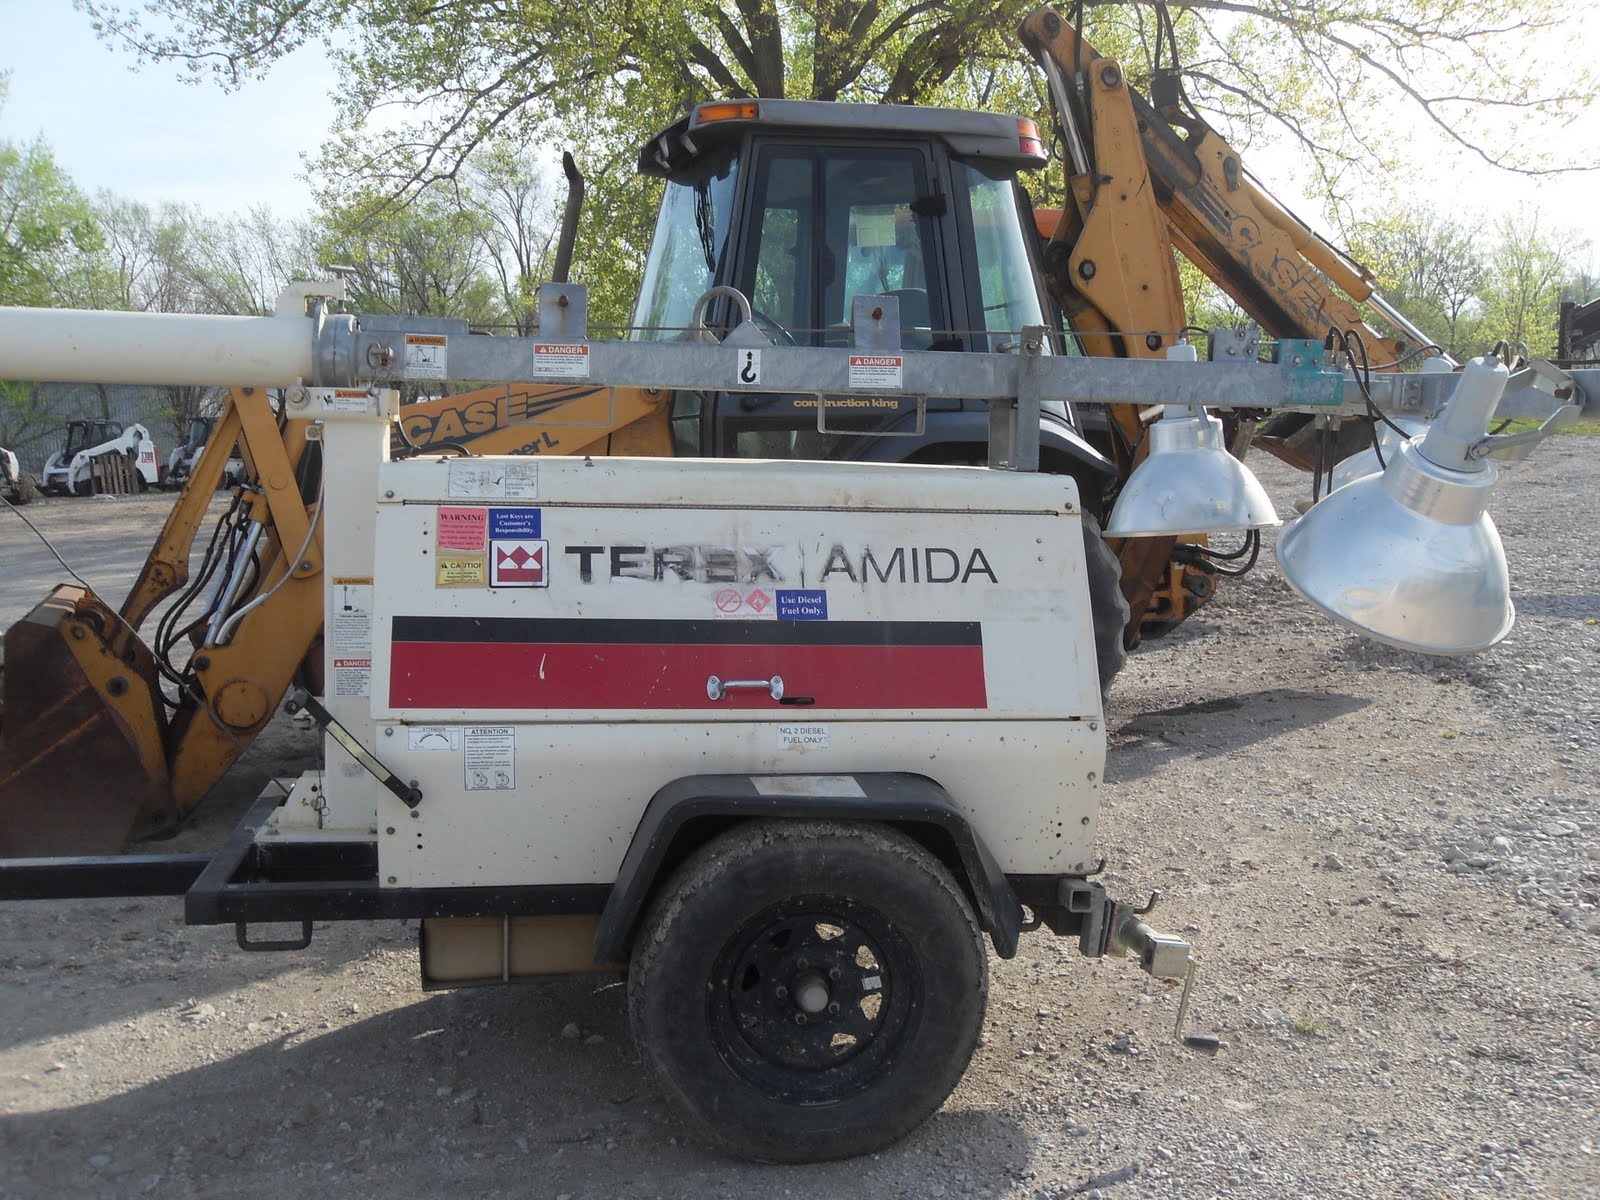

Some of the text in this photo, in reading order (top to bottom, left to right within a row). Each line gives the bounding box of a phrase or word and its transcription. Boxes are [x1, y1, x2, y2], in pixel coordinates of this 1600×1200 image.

[548, 346, 583, 354] DANGER
[863, 358, 897, 366] DANGER
[793, 398, 899, 410] contruction king
[401, 391, 528, 447] CASE
[542, 431, 560, 449] L
[440, 513, 484, 521] WARNING
[564, 545, 999, 584] TEREX AMIDA
[781, 596, 822, 604] Use Diesel
[781, 606, 824, 616] Fuel Only.
[800, 727, 826, 735] DIESEL
